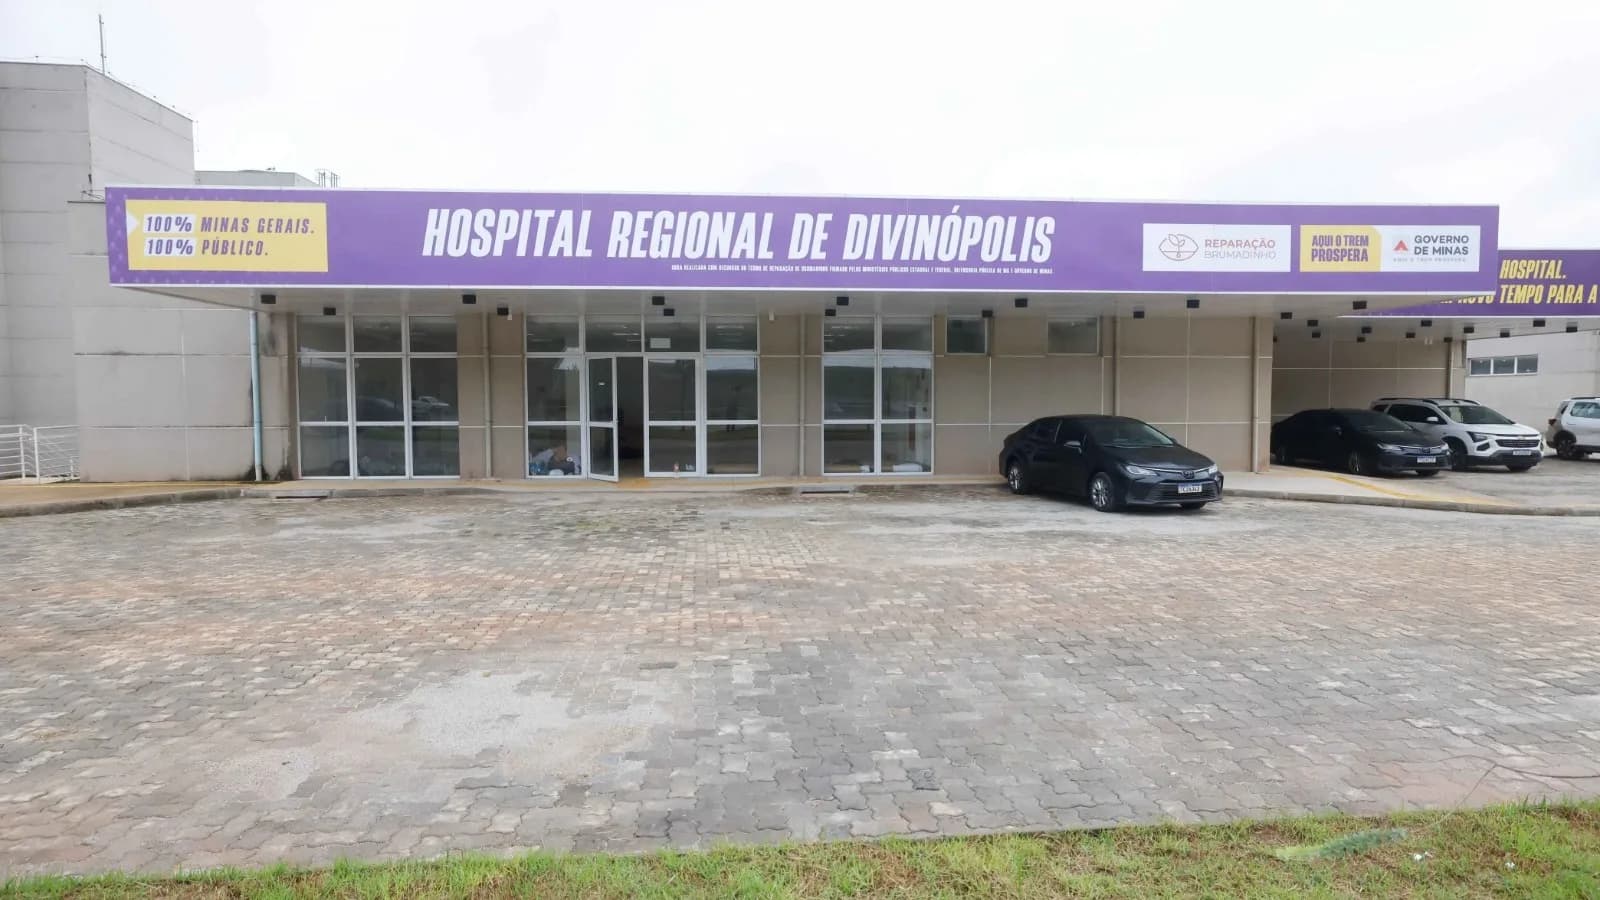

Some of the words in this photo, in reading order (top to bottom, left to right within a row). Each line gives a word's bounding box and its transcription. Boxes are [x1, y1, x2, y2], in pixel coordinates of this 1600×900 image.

[146, 216, 192, 232] 100%
[200, 217, 249, 233] MINAS
[257, 218, 314, 234] GERAIS.
[422, 208, 592, 257] HOSPITAL
[606, 210, 774, 260] REGIONAL
[788, 213, 833, 260] DE
[842, 205, 1055, 263] DIVINÓPOLIS
[1312, 235, 1333, 246] AQUI
[1336, 235, 1341, 246] O
[1344, 235, 1369, 246] TREM
[1414, 235, 1469, 244] GOVERNO
[148, 239, 193, 255] 100%
[201, 236, 268, 256] PÚBLICO.
[1204, 238, 1276, 250] REPARAÇÃO
[1414, 246, 1429, 255] DE
[1432, 246, 1469, 255] MINAS
[1204, 251, 1276, 259] BRUMADINHO
[1311, 249, 1368, 262] PROSPERA
[1500, 259, 1566, 279] HOSPITAL.
[1500, 284, 1544, 304] TEMPO
[1546, 284, 1584, 304] PARA
[1587, 284, 1598, 304] A
